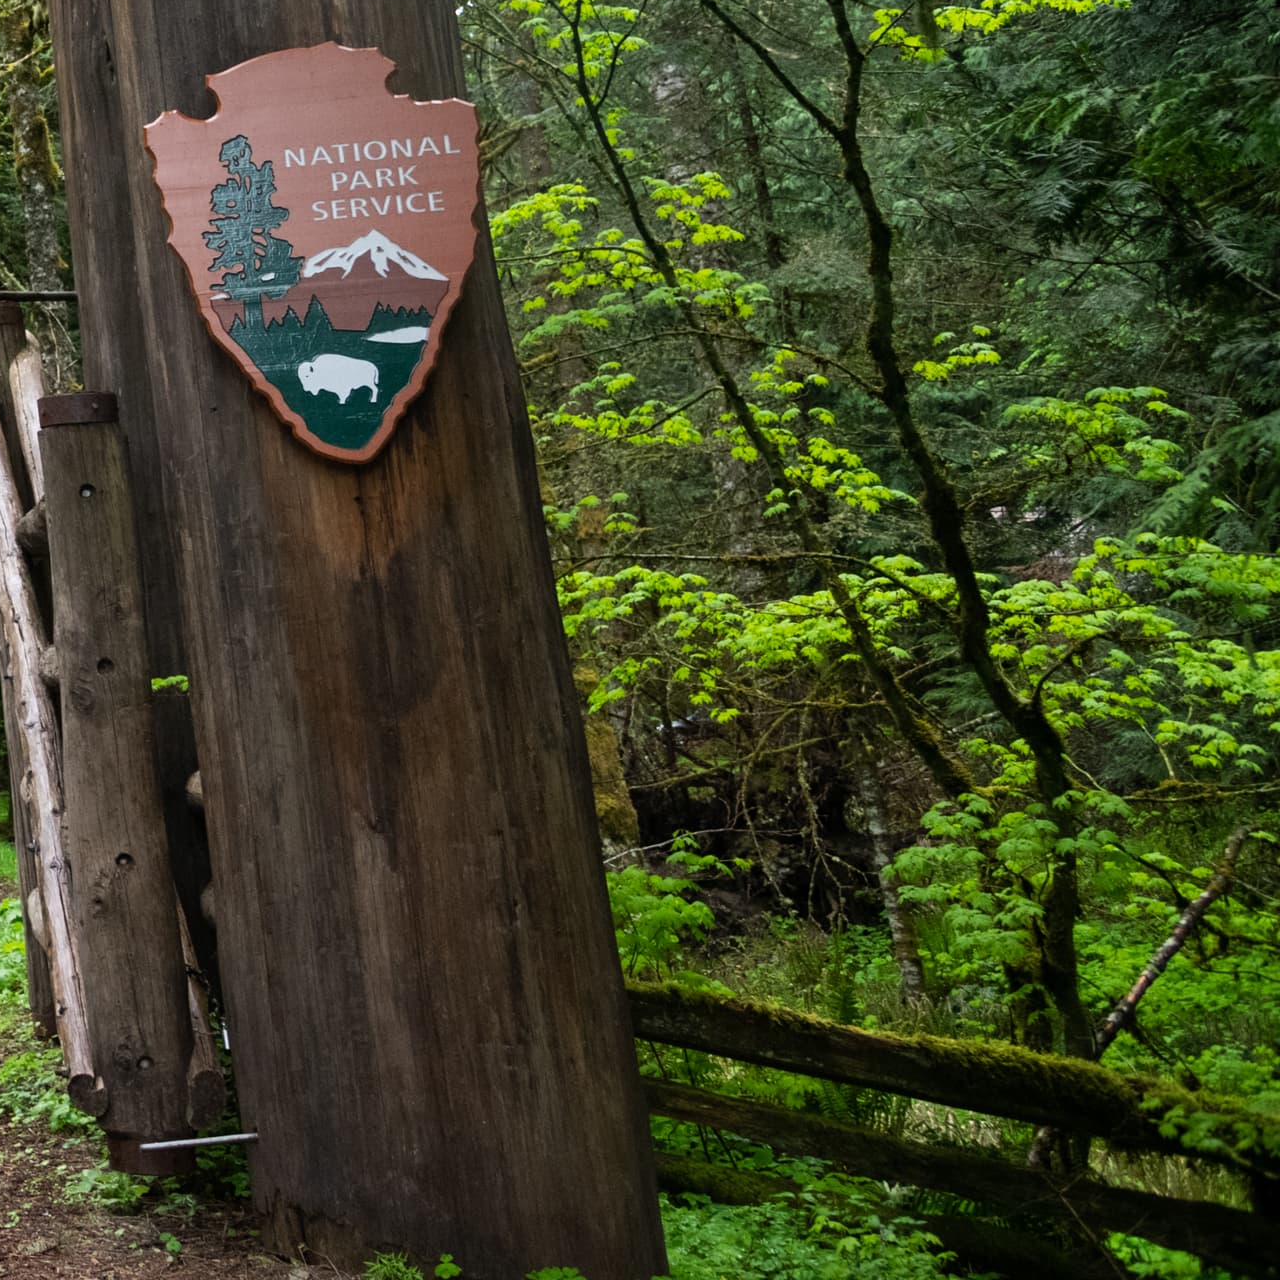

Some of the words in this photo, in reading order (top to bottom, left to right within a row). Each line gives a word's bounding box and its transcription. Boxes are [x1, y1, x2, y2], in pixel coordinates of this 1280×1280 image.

[284, 135, 460, 167] NATIONAL
[330, 164, 419, 192] PARK
[311, 191, 445, 220] SERVICE
